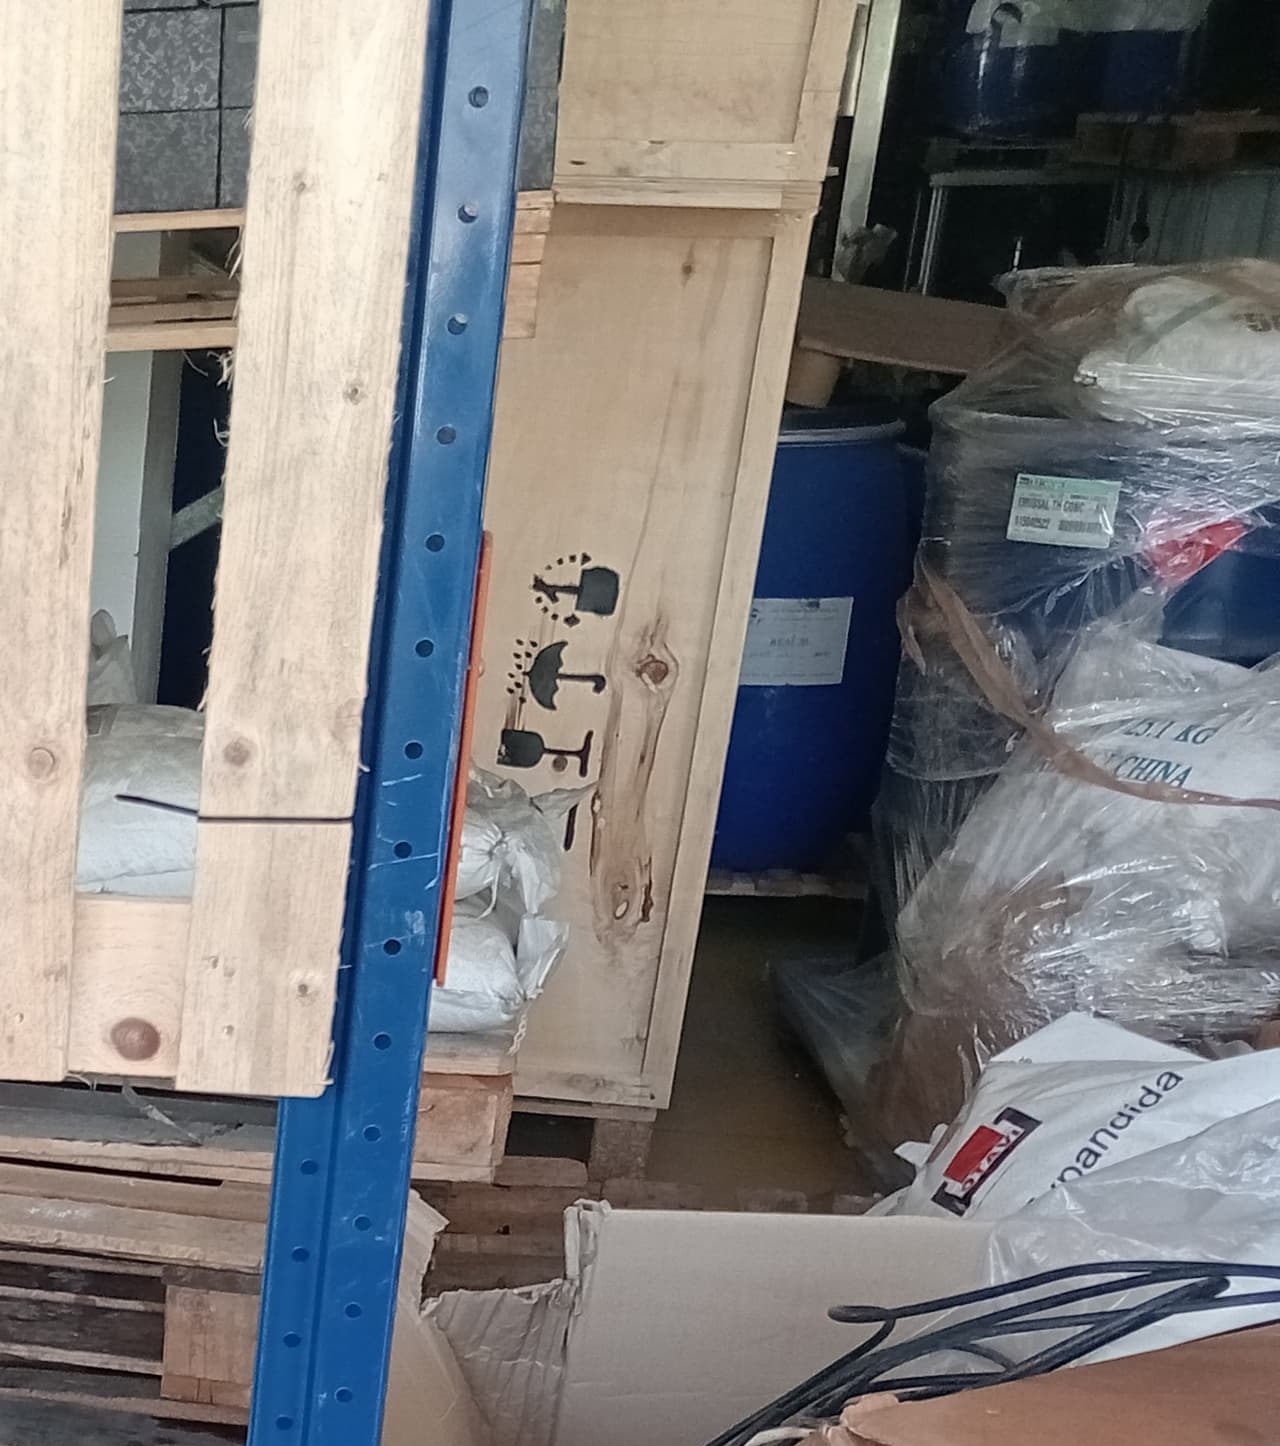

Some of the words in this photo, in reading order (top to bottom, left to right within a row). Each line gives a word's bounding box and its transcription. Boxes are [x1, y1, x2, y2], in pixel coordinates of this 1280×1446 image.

[1174, 721, 1218, 745] KG
[1114, 755, 1193, 787] CHINA
[1028, 1071, 1184, 1204] pandida
